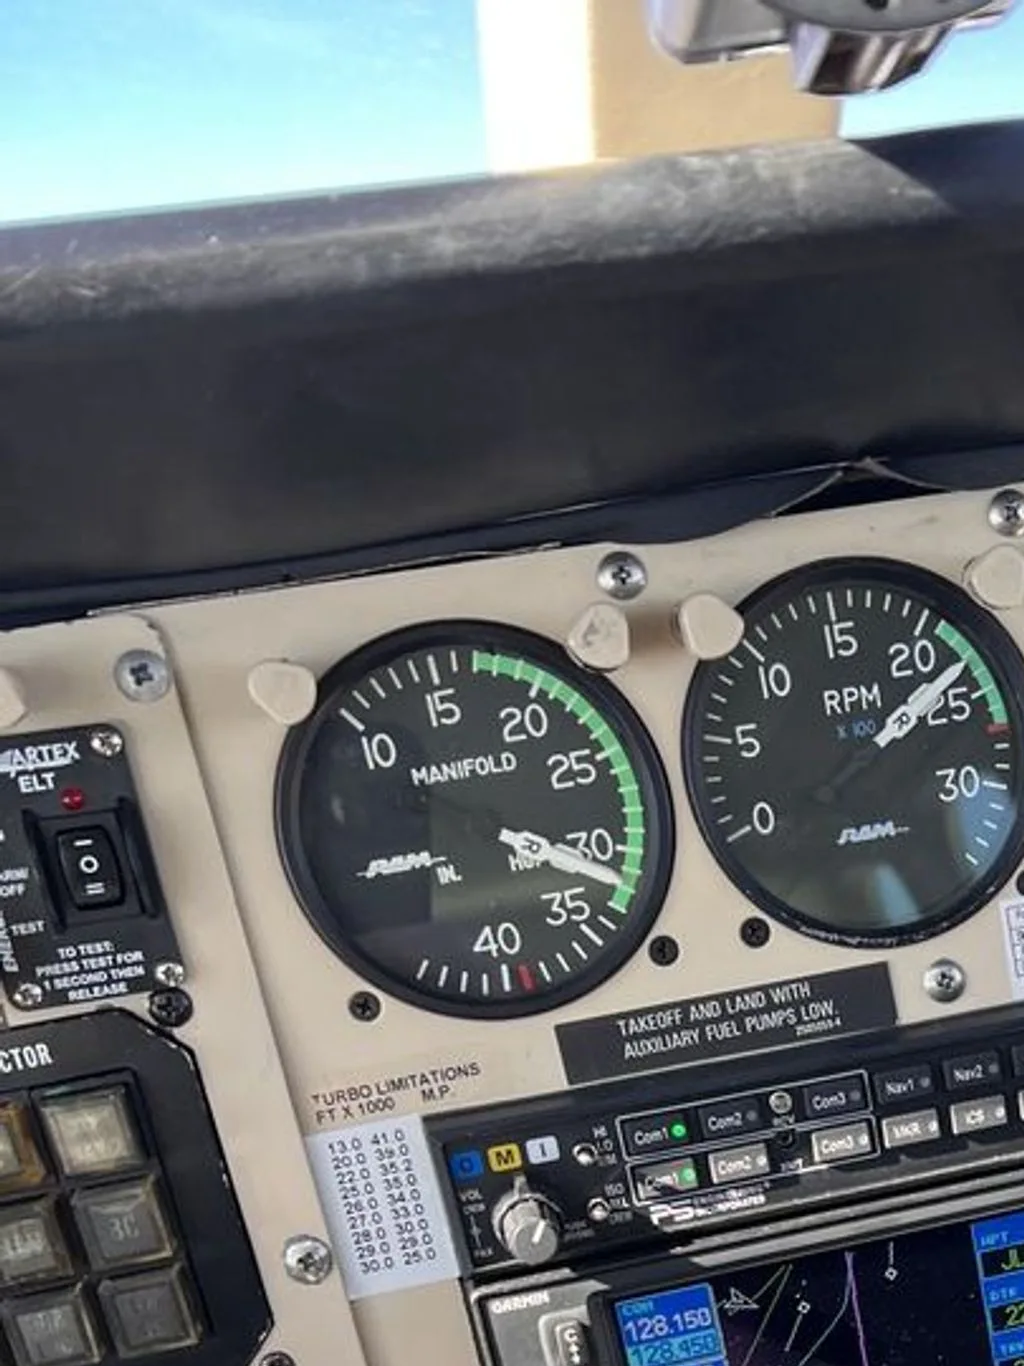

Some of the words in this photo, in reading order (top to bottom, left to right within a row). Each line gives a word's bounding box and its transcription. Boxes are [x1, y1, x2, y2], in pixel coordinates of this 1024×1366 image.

[824, 622, 858, 659] 15
[889, 639, 934, 678] 20
[759, 663, 790, 699] 10
[426, 689, 461, 727] 15
[824, 684, 881, 715] RPM
[928, 688, 971, 726] 25
[501, 704, 547, 742] 20
[362, 733, 396, 769] 10
[736, 724, 760, 758] 5
[411, 753, 517, 785] MANIFOLD
[547, 750, 596, 789] 25
[18, 773, 56, 793] ELT
[936, 766, 979, 801] 30
[754, 802, 774, 835] 0
[541, 888, 590, 926] 35
[57, 945, 78, 958] TO
[474, 922, 521, 957] 40
[35, 962, 78, 978] PRESS
[81, 958, 113, 972] TEST
[116, 951, 144, 966] FOR
[54, 972, 107, 989] SECOND
[110, 966, 145, 980] THEN
[68, 983, 128, 1001] RELEASE
[617, 1009, 683, 1037] TAKEOFF
[690, 1002, 722, 1021] AND
[726, 991, 766, 1015] LAND
[771, 982, 810, 1004] WITH
[624, 1028, 700, 1059] AUXILIARY
[706, 1020, 741, 1041] FUEL
[745, 1006, 797, 1033] PUMPS
[312, 1085, 372, 1106] TURBO
[376, 1063, 481, 1094] LIMITATIONS
[886, 1078, 914, 1095] Nav1
[954, 1065, 983, 1081] Nav2
[317, 1109, 335, 1125] FT
[343, 1105, 354, 1119] X
[358, 1098, 395, 1116] 1000
[812, 1092, 846, 1109] Com3
[708, 1114, 742, 1130] Com2
[328, 1138, 362, 1155] 13.0
[370, 1129, 405, 1146] 41.0
[635, 1128, 668, 1145] Com1
[332, 1153, 366, 1171] 20.0
[495, 1149, 515, 1166] M
[336, 1168, 370, 1185] 22.0
[379, 1159, 413, 1177] 35.2
[340, 1183, 375, 1200] 25.0
[344, 1198, 378, 1215] 26.0
[387, 1190, 421, 1206] 34.0
[348, 1213, 382, 1230] 27.0
[391, 1204, 424, 1220] 33.0
[352, 1228, 386, 1245] 28.0
[395, 1219, 429, 1235] 30.0
[356, 1243, 390, 1259] 29.0
[360, 1257, 394, 1274] 30.0
[403, 1249, 436, 1265] 25.0
[625, 1307, 711, 1342] 128.150
